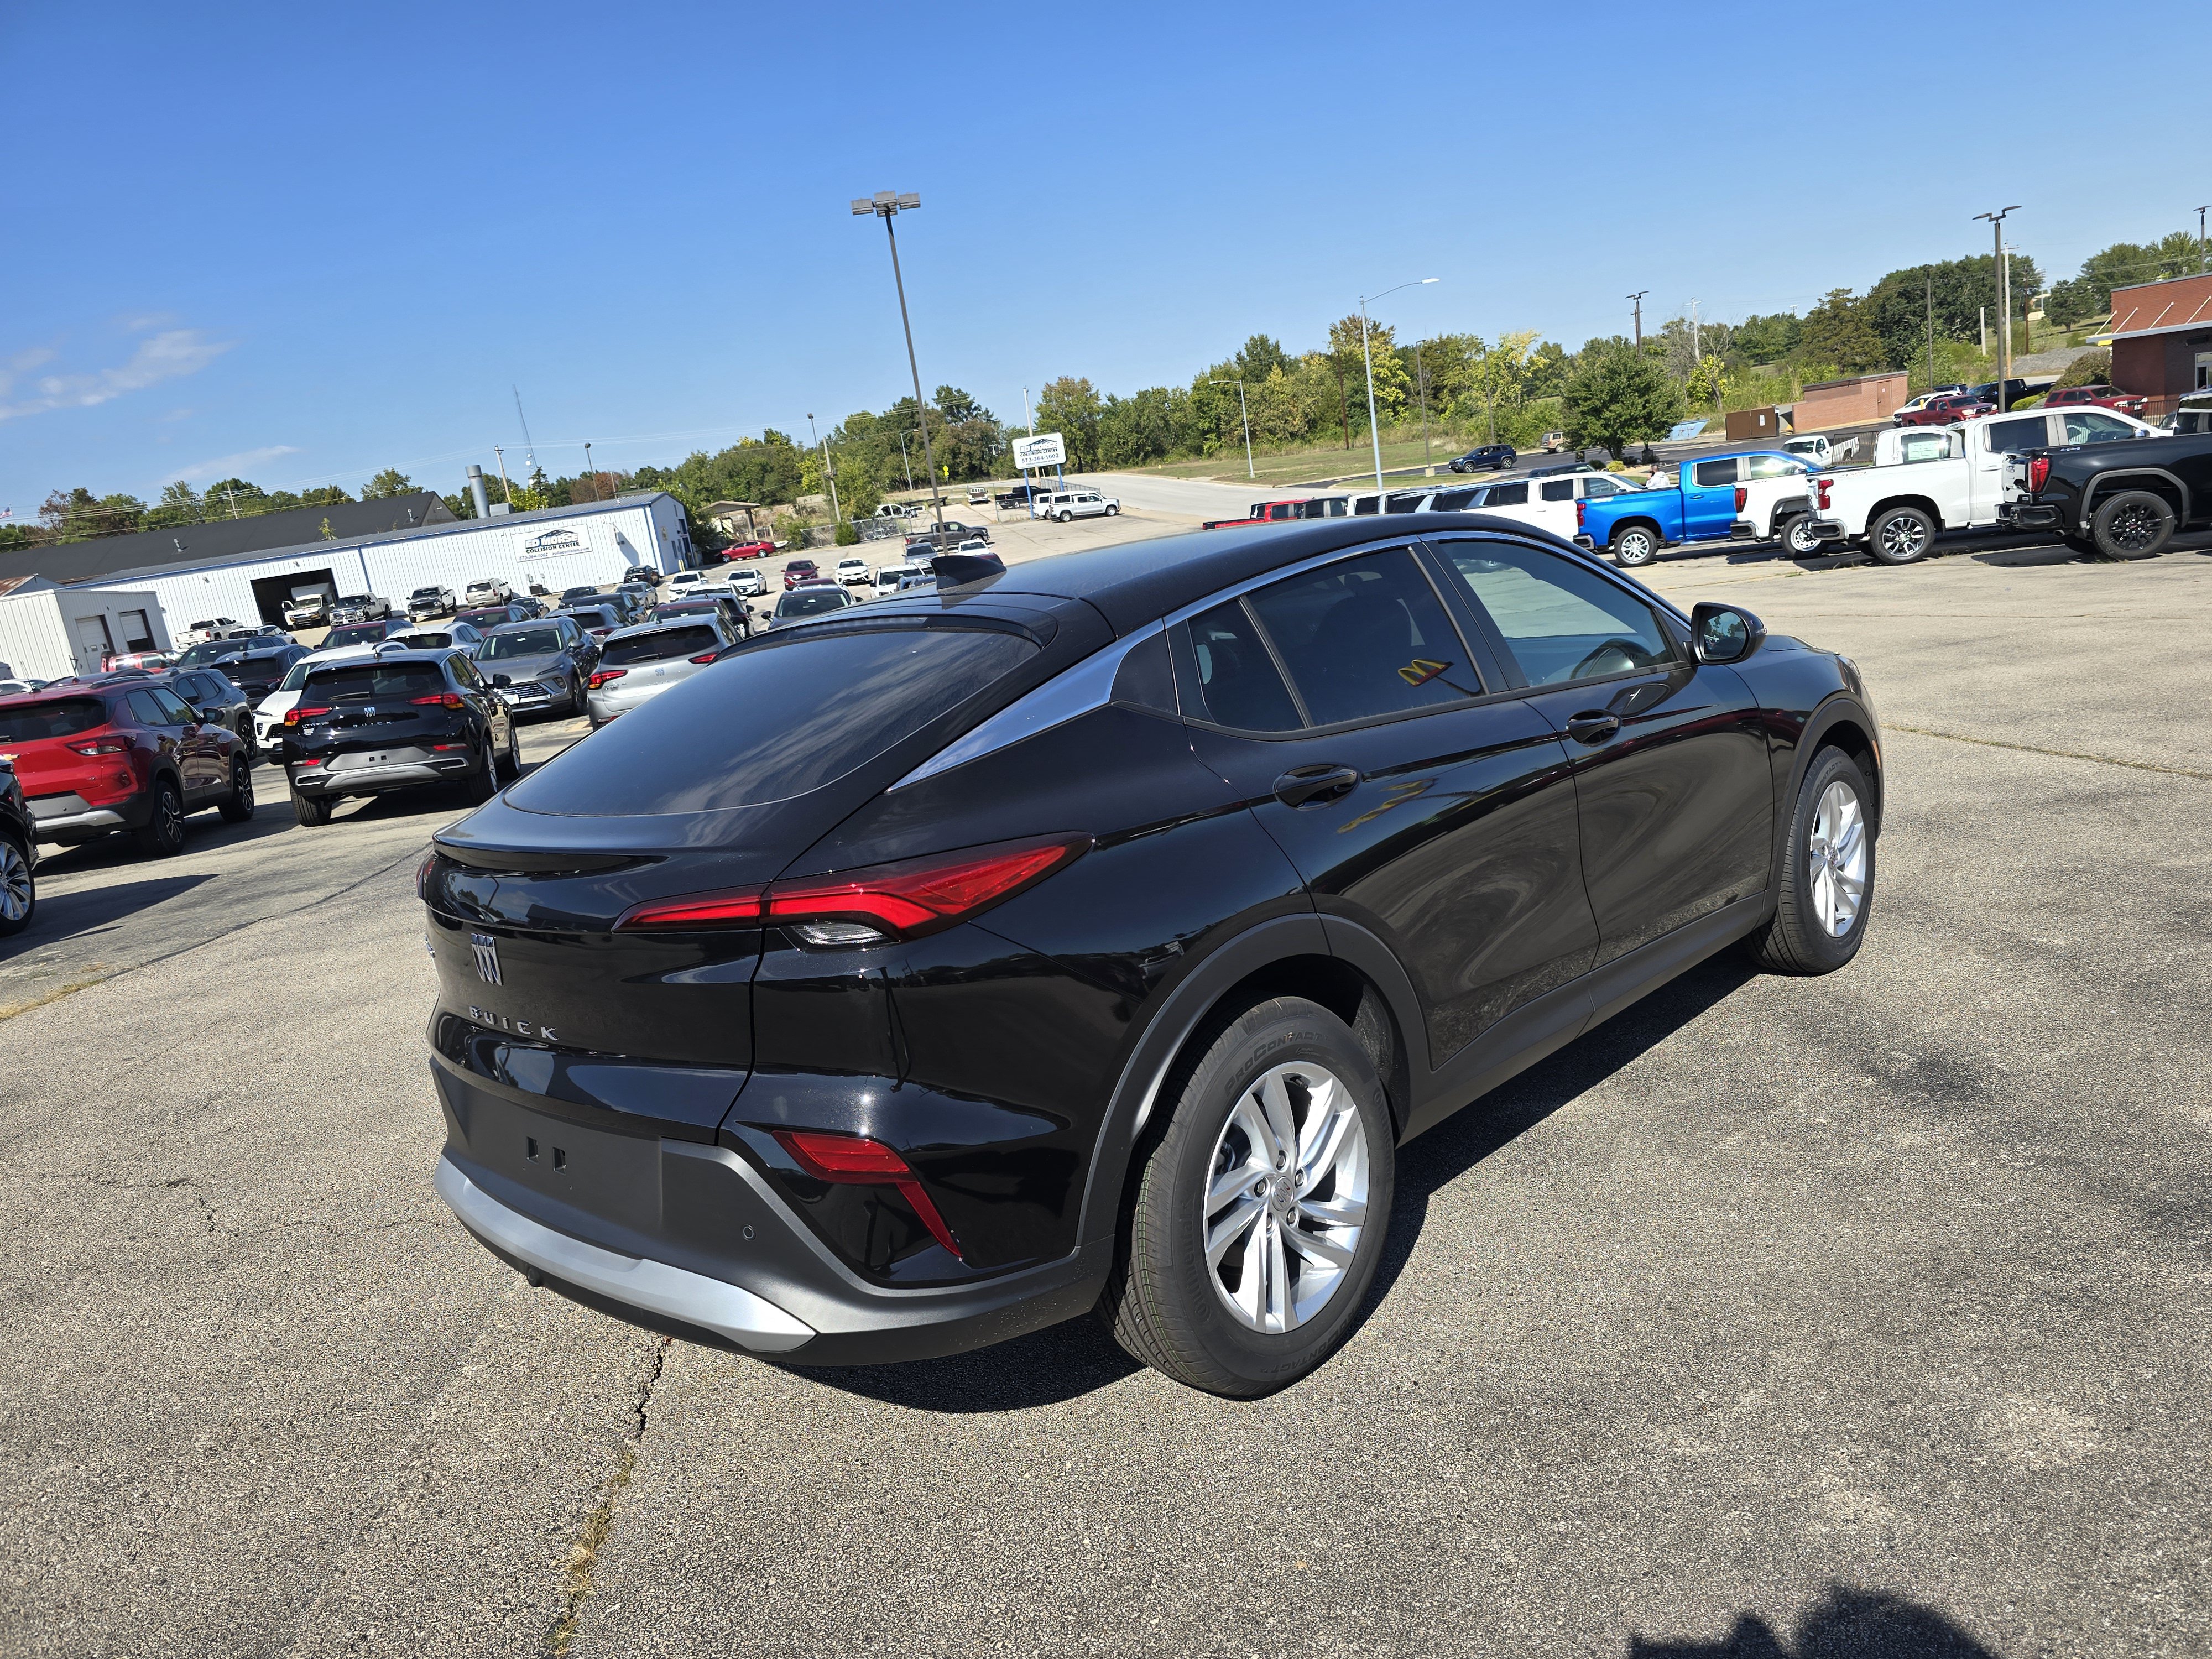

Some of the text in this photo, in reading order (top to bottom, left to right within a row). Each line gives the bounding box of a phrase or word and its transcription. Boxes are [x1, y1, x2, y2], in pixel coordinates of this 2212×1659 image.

[1022, 453, 1059, 463] 573-364-1002
[525, 533, 578, 549] ED MORSE
[469, 1005, 560, 1041] BUICK
